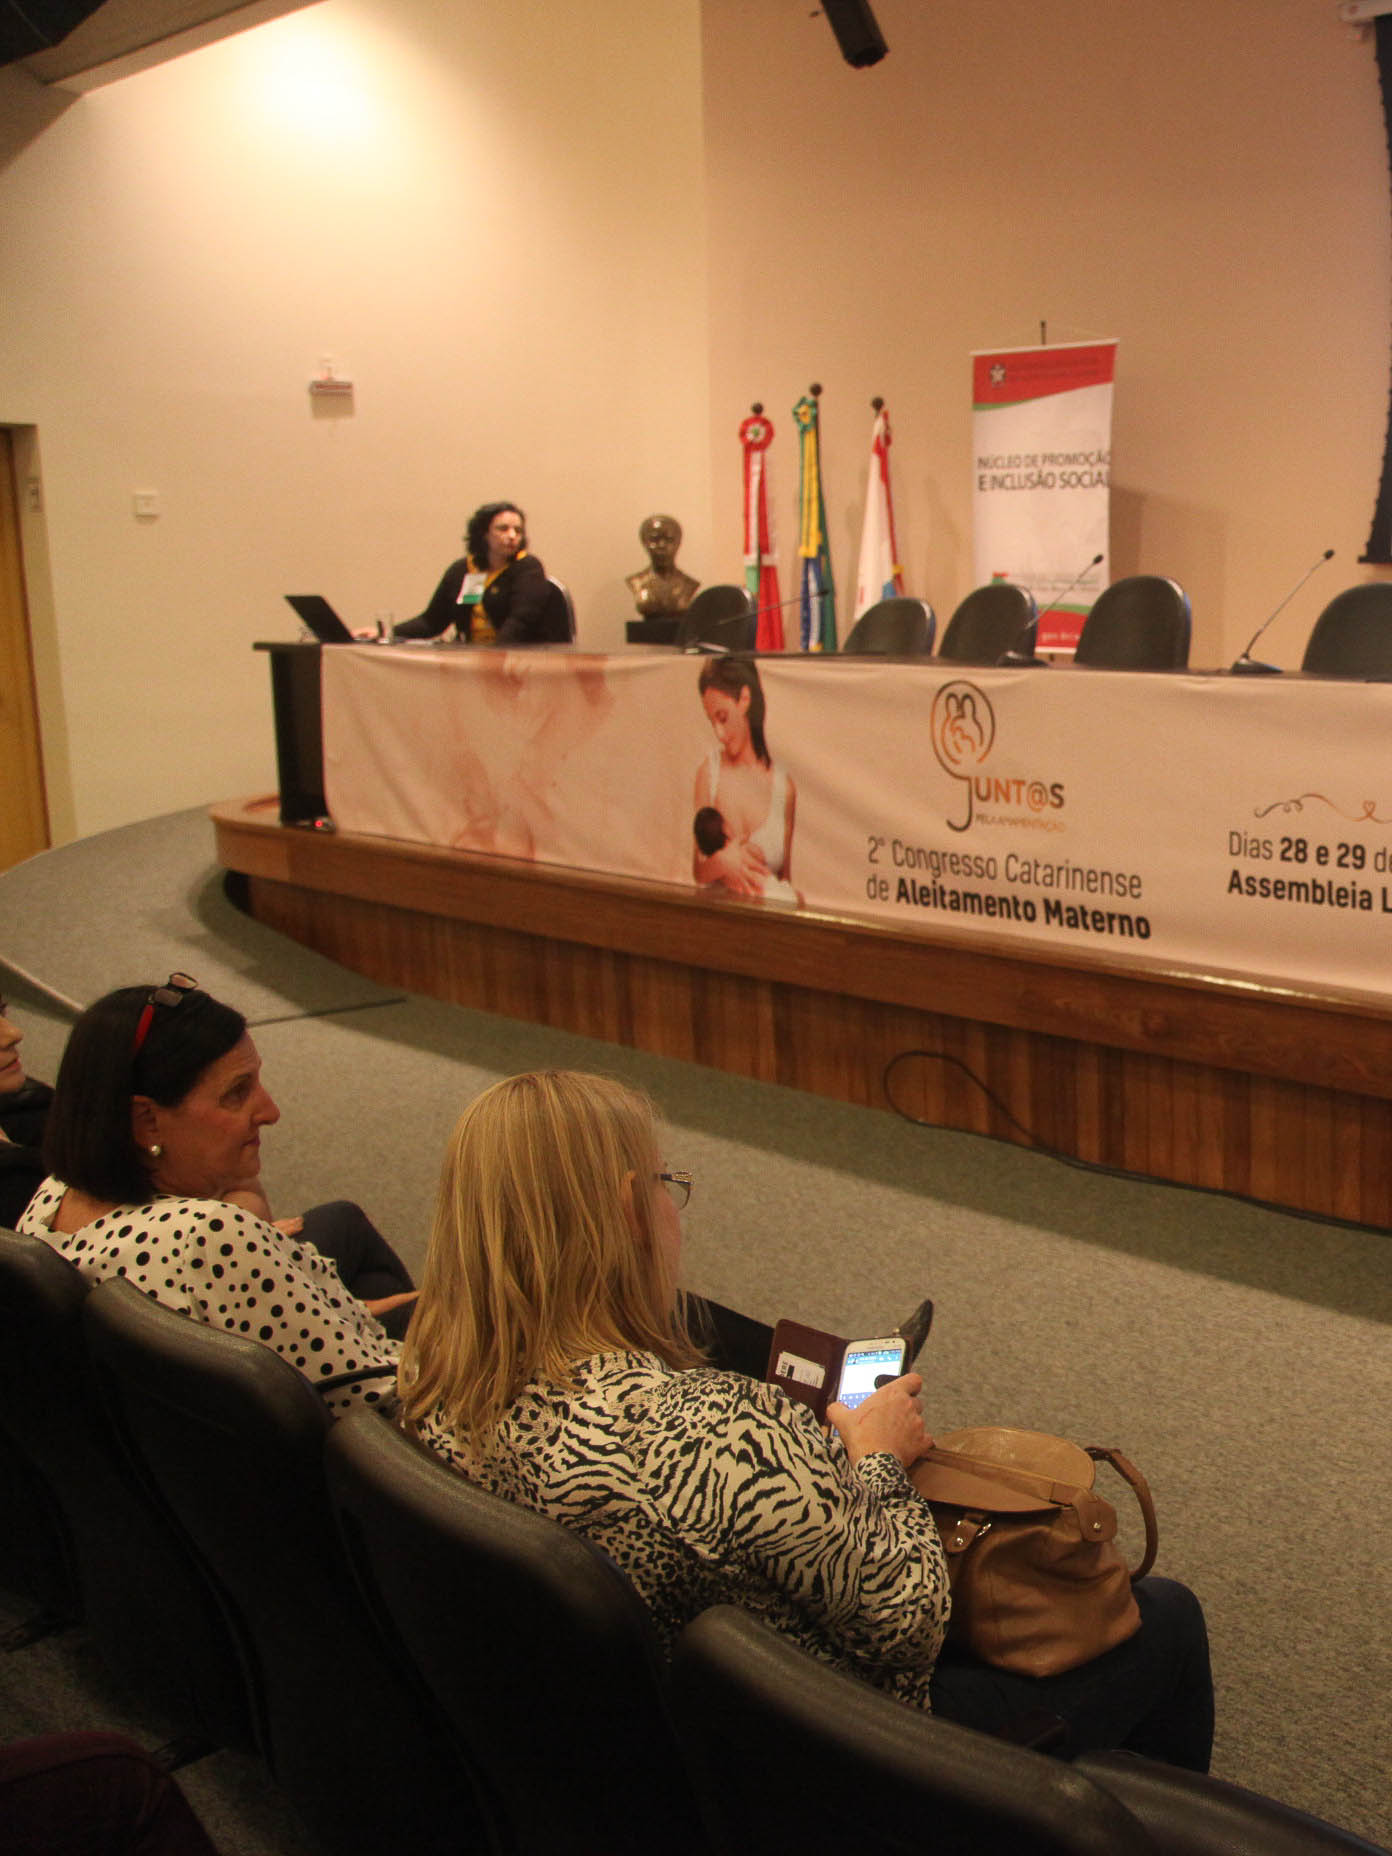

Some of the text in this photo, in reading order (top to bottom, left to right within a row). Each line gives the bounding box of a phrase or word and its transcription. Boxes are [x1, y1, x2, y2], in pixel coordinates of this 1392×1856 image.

[891, 839, 998, 880] Congresso
[1005, 854, 1143, 899] Catarinense
[1228, 830, 1274, 860] Dias
[1279, 836, 1308, 864] 28
[1315, 844, 1329, 866] e
[1336, 842, 1366, 870] 29
[866, 875, 1151, 940] de Aleitamento Materno
[1227, 869, 1373, 911] Assembleia
